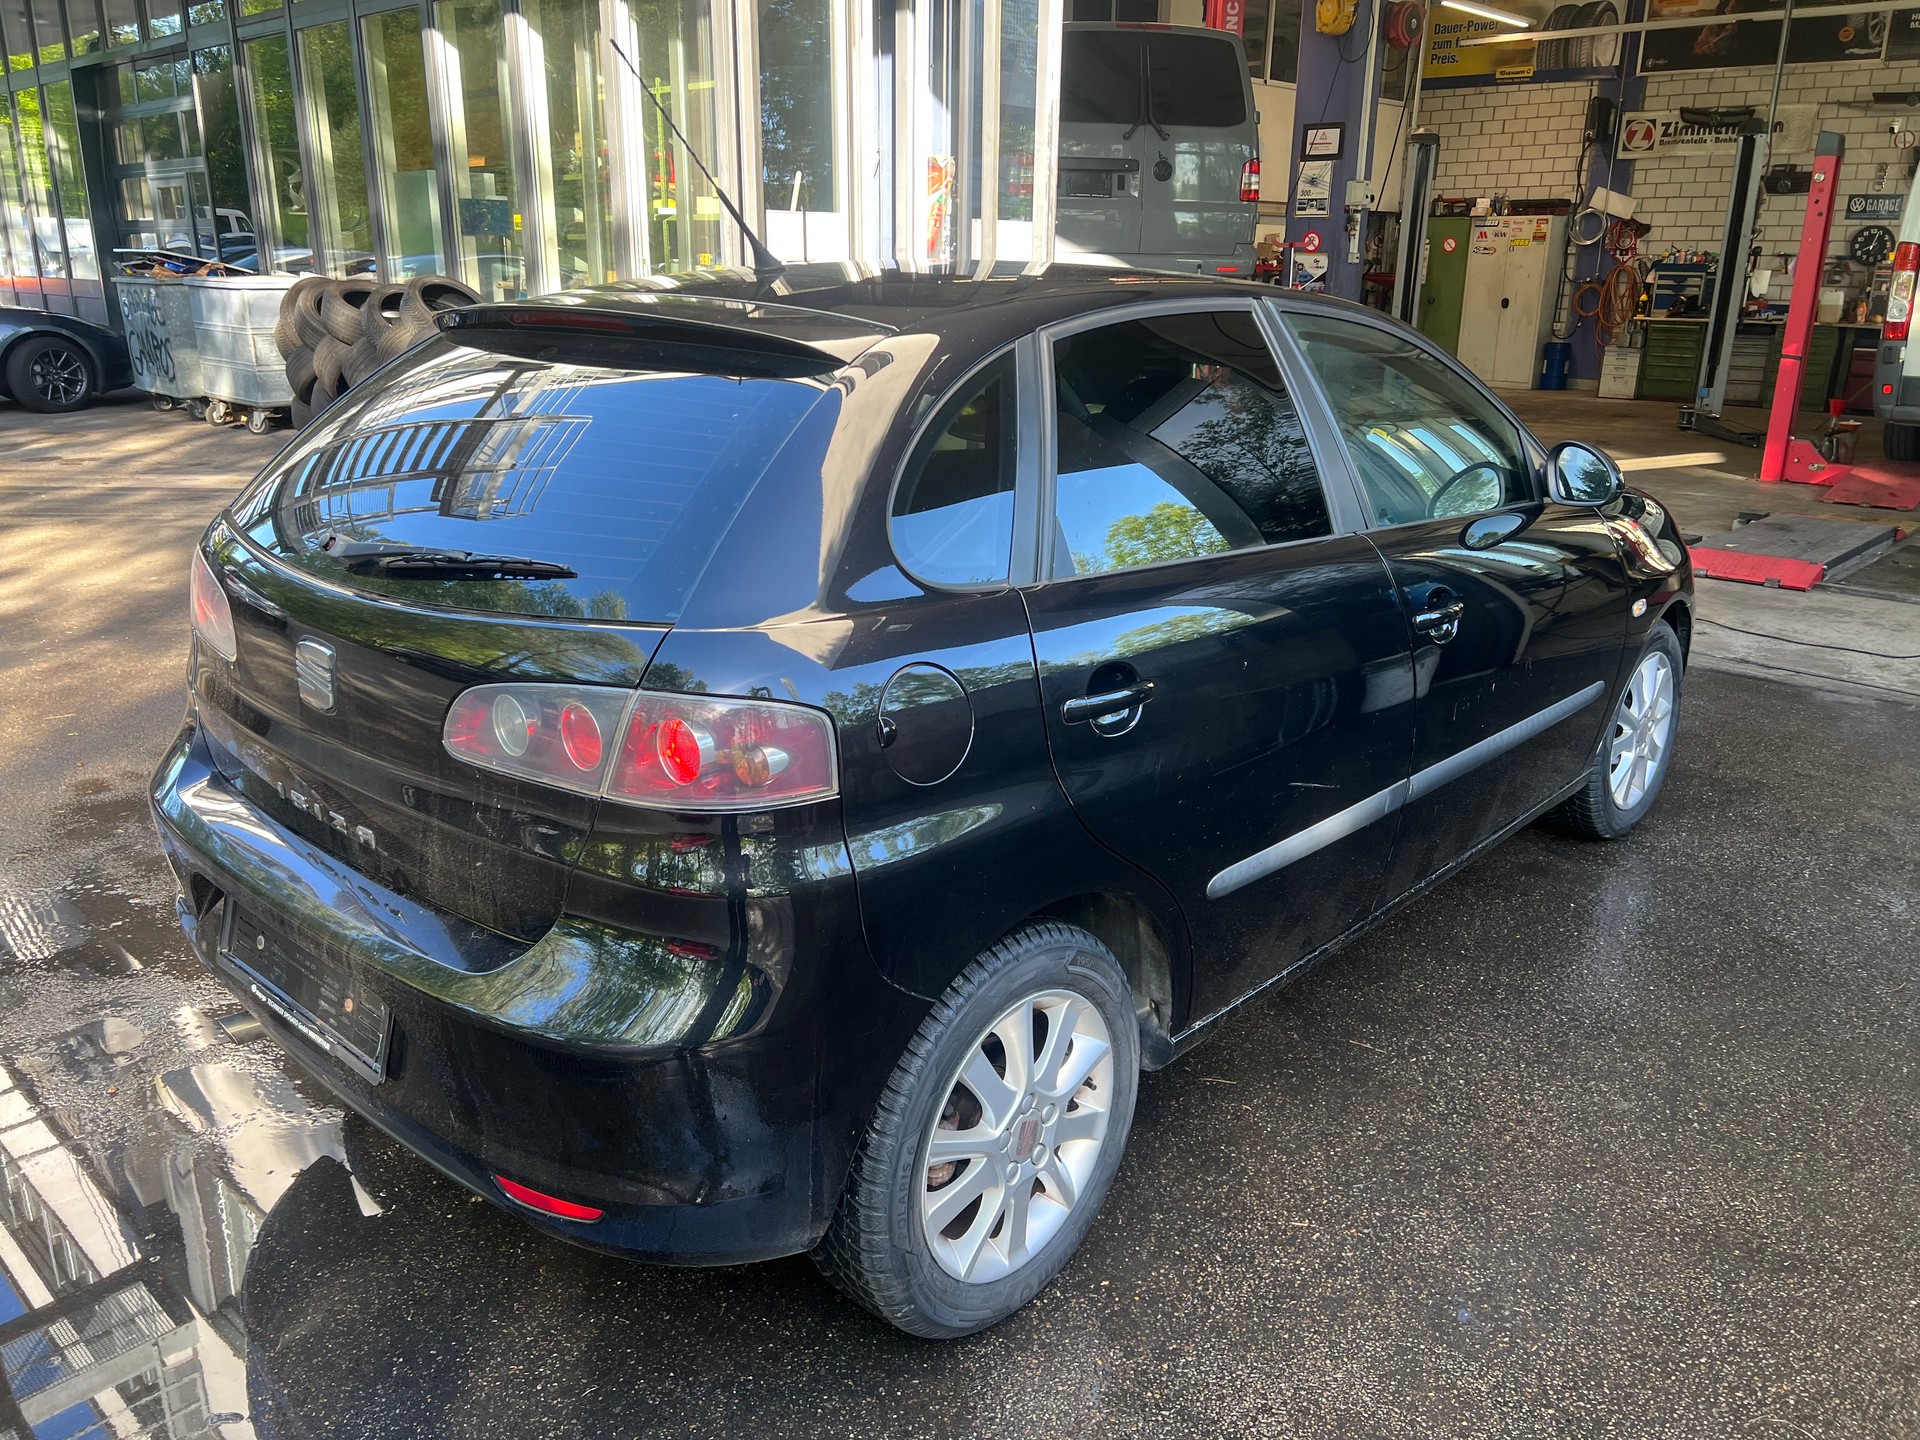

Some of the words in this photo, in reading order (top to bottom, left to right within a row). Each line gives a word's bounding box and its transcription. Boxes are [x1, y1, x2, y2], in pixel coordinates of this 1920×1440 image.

[1434, 20, 1499, 35] Dauer-Power
[1431, 40, 1452, 50] zum
[1430, 52, 1459, 65] Preis.
[1866, 198, 1900, 211] GARAGE
[277, 781, 377, 850] IBIZA
[897, 1163, 912, 1241] POLARIS
